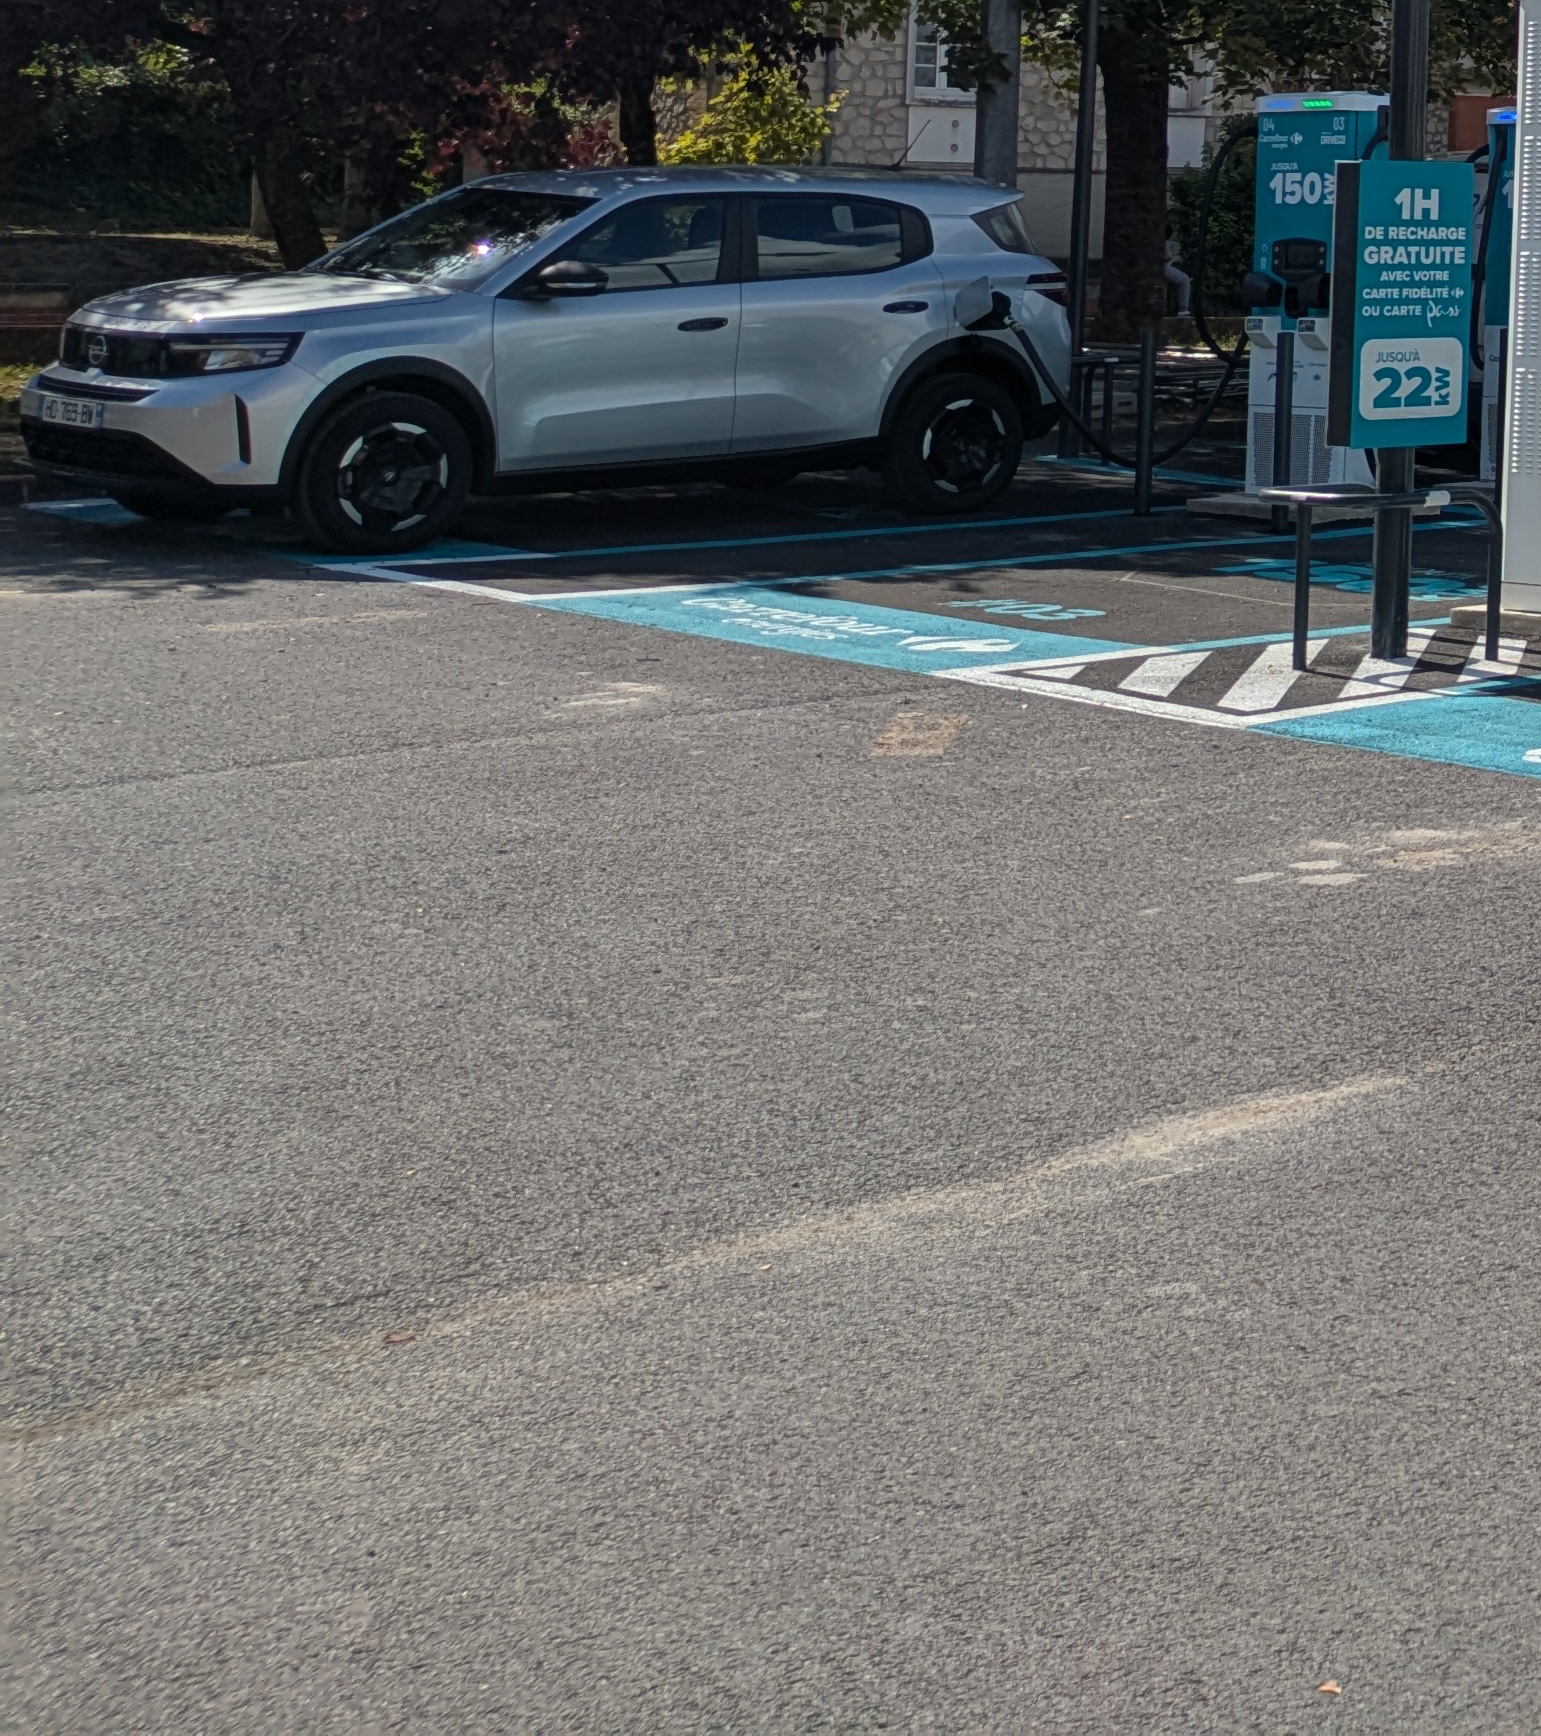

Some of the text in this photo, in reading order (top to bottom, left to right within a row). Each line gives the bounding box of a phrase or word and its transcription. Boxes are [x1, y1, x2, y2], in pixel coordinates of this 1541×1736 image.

[1269, 171, 1322, 205] 150
[1394, 187, 1440, 221] 1H
[1364, 226, 1467, 240] DE RECHARGE
[1363, 246, 1466, 265] GRATUITE
[1380, 270, 1450, 282] AVEC VOTRE
[1362, 284, 1450, 299] CARTE FIDÉLITÉ
[1362, 305, 1380, 317] OU
[1383, 305, 1422, 317] CARTE
[1375, 348, 1421, 364] JUSQU'À
[1372, 365, 1451, 409] 22 kW
